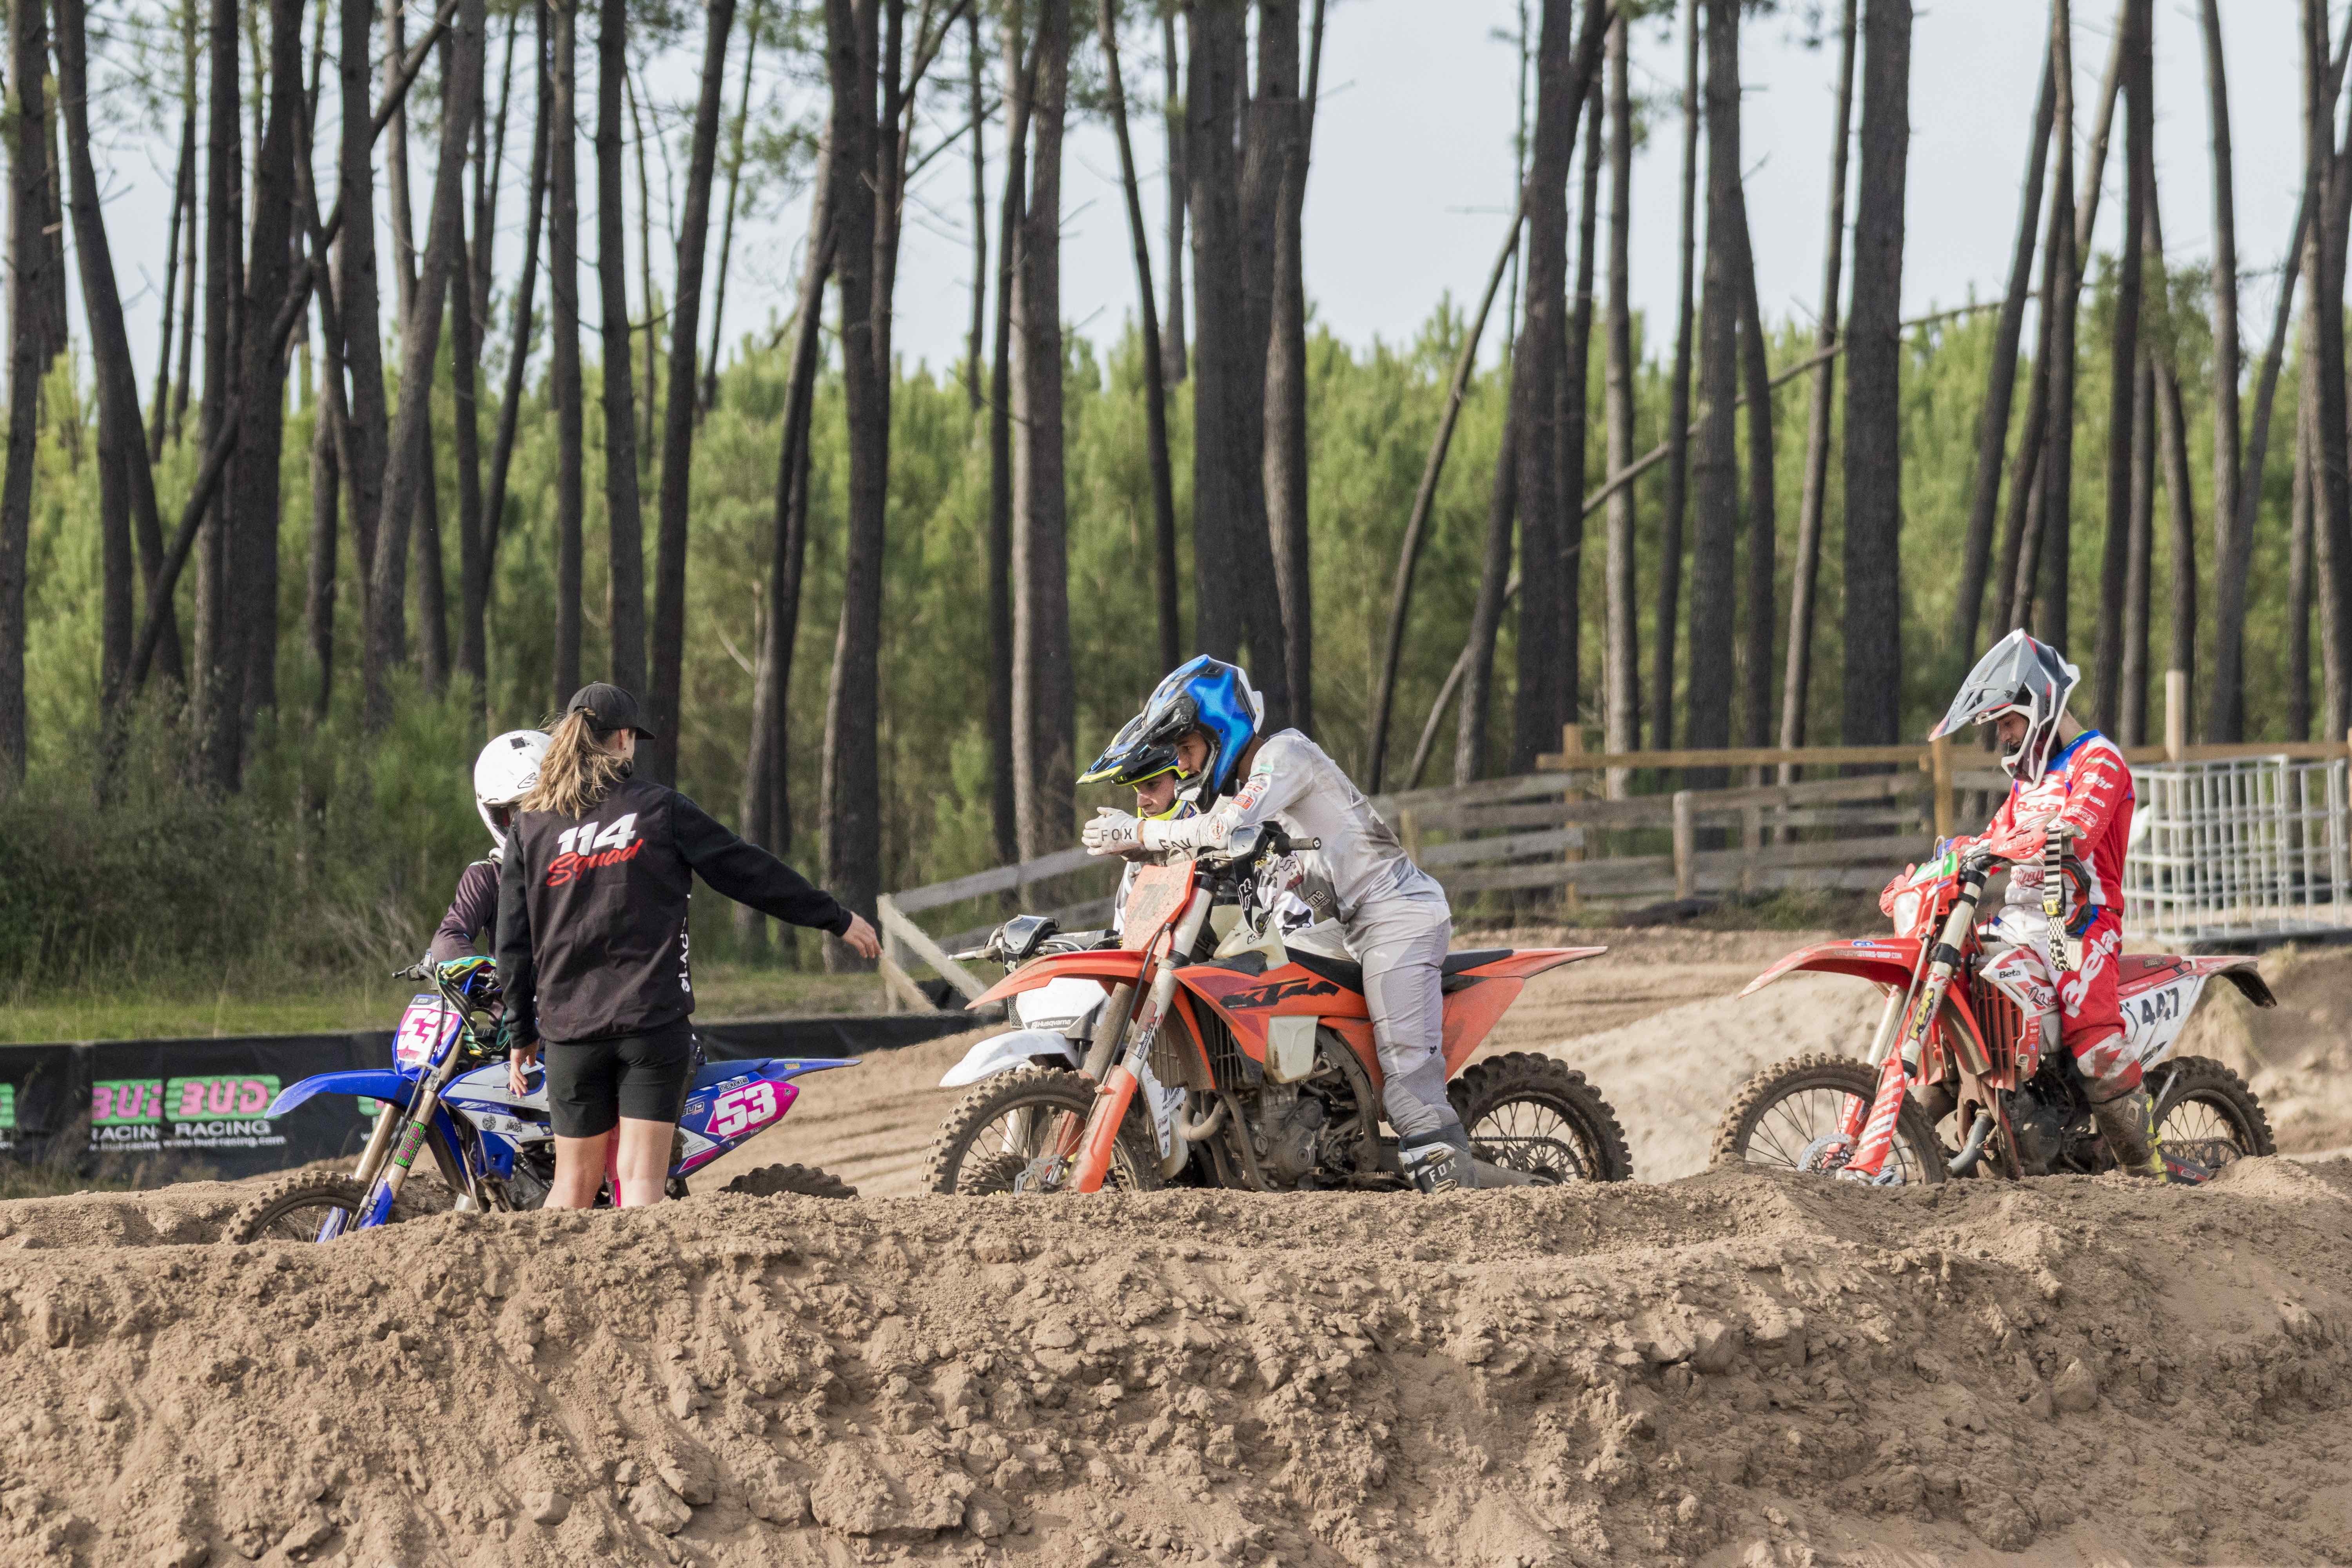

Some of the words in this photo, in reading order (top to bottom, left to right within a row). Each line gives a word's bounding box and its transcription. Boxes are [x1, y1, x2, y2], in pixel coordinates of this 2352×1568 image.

[557, 813, 638, 856] 114
[1101, 828, 1132, 842] FOX
[546, 838, 644, 887] Squad
[1999, 968, 2021, 978] Beta
[2061, 928, 2121, 1018] Beta
[1219, 977, 1341, 1009] KTM
[2141, 987, 2179, 1025] 447
[397, 1009, 454, 1058] 53
[1138, 1028, 1152, 1058] TECHNOLOGY
[179, 1080, 269, 1116] BUD
[714, 1082, 777, 1136] 53
[91, 1125, 160, 1142] ACIN
[175, 1120, 271, 1137] RACING
[400, 1126, 420, 1161] BUD
[1428, 1157, 1457, 1182] FOX
